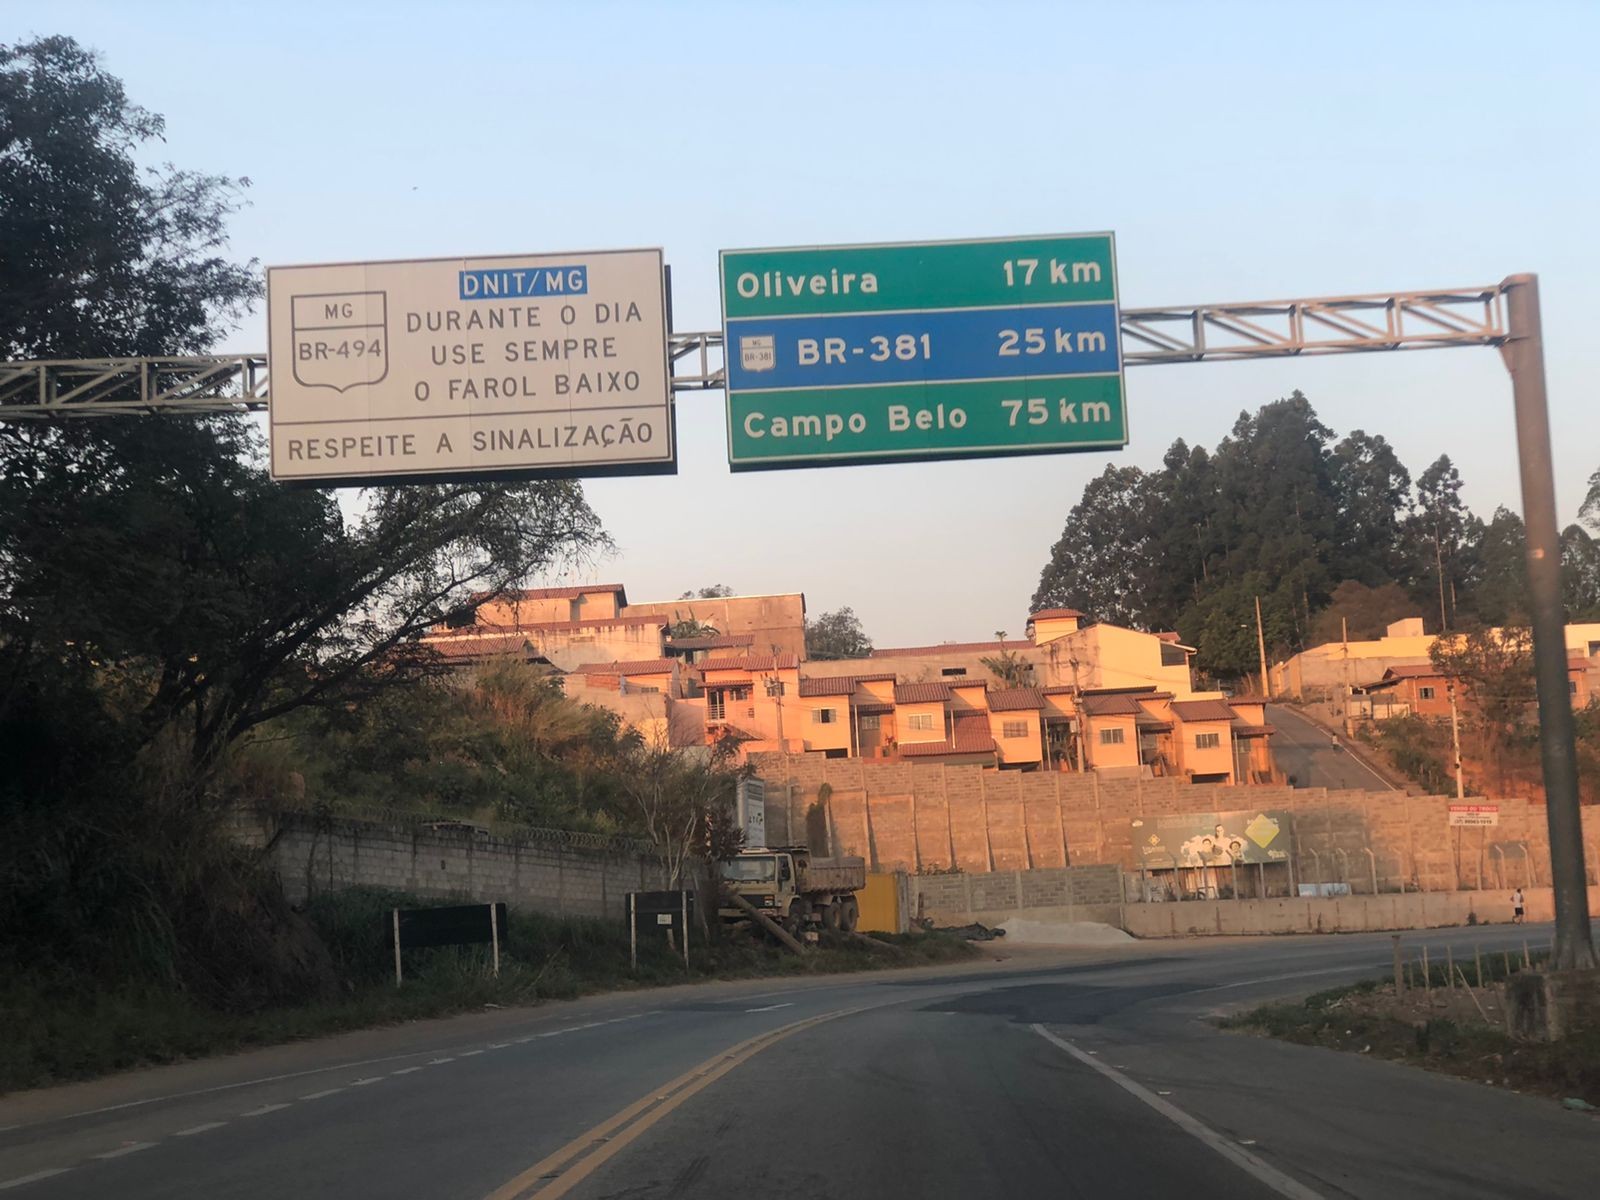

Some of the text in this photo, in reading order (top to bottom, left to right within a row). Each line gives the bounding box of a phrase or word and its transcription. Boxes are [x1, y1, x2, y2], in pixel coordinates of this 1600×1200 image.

[463, 270, 584, 297] DNIT/MG
[736, 258, 1102, 299] Oliveira 17 km
[325, 303, 353, 320] MG
[406, 301, 643, 333] DURANTE O DIA
[299, 338, 383, 361] BR-494
[431, 337, 618, 366] USE SEMPRE
[744, 352, 772, 362] BR-381
[797, 327, 1107, 366] BR-381 25 km
[414, 370, 641, 402] O FAROL BAIXO
[743, 398, 1111, 442] Campo Belo 75 km
[288, 417, 653, 461] RESPEITE A SINALIZAÇÃO
